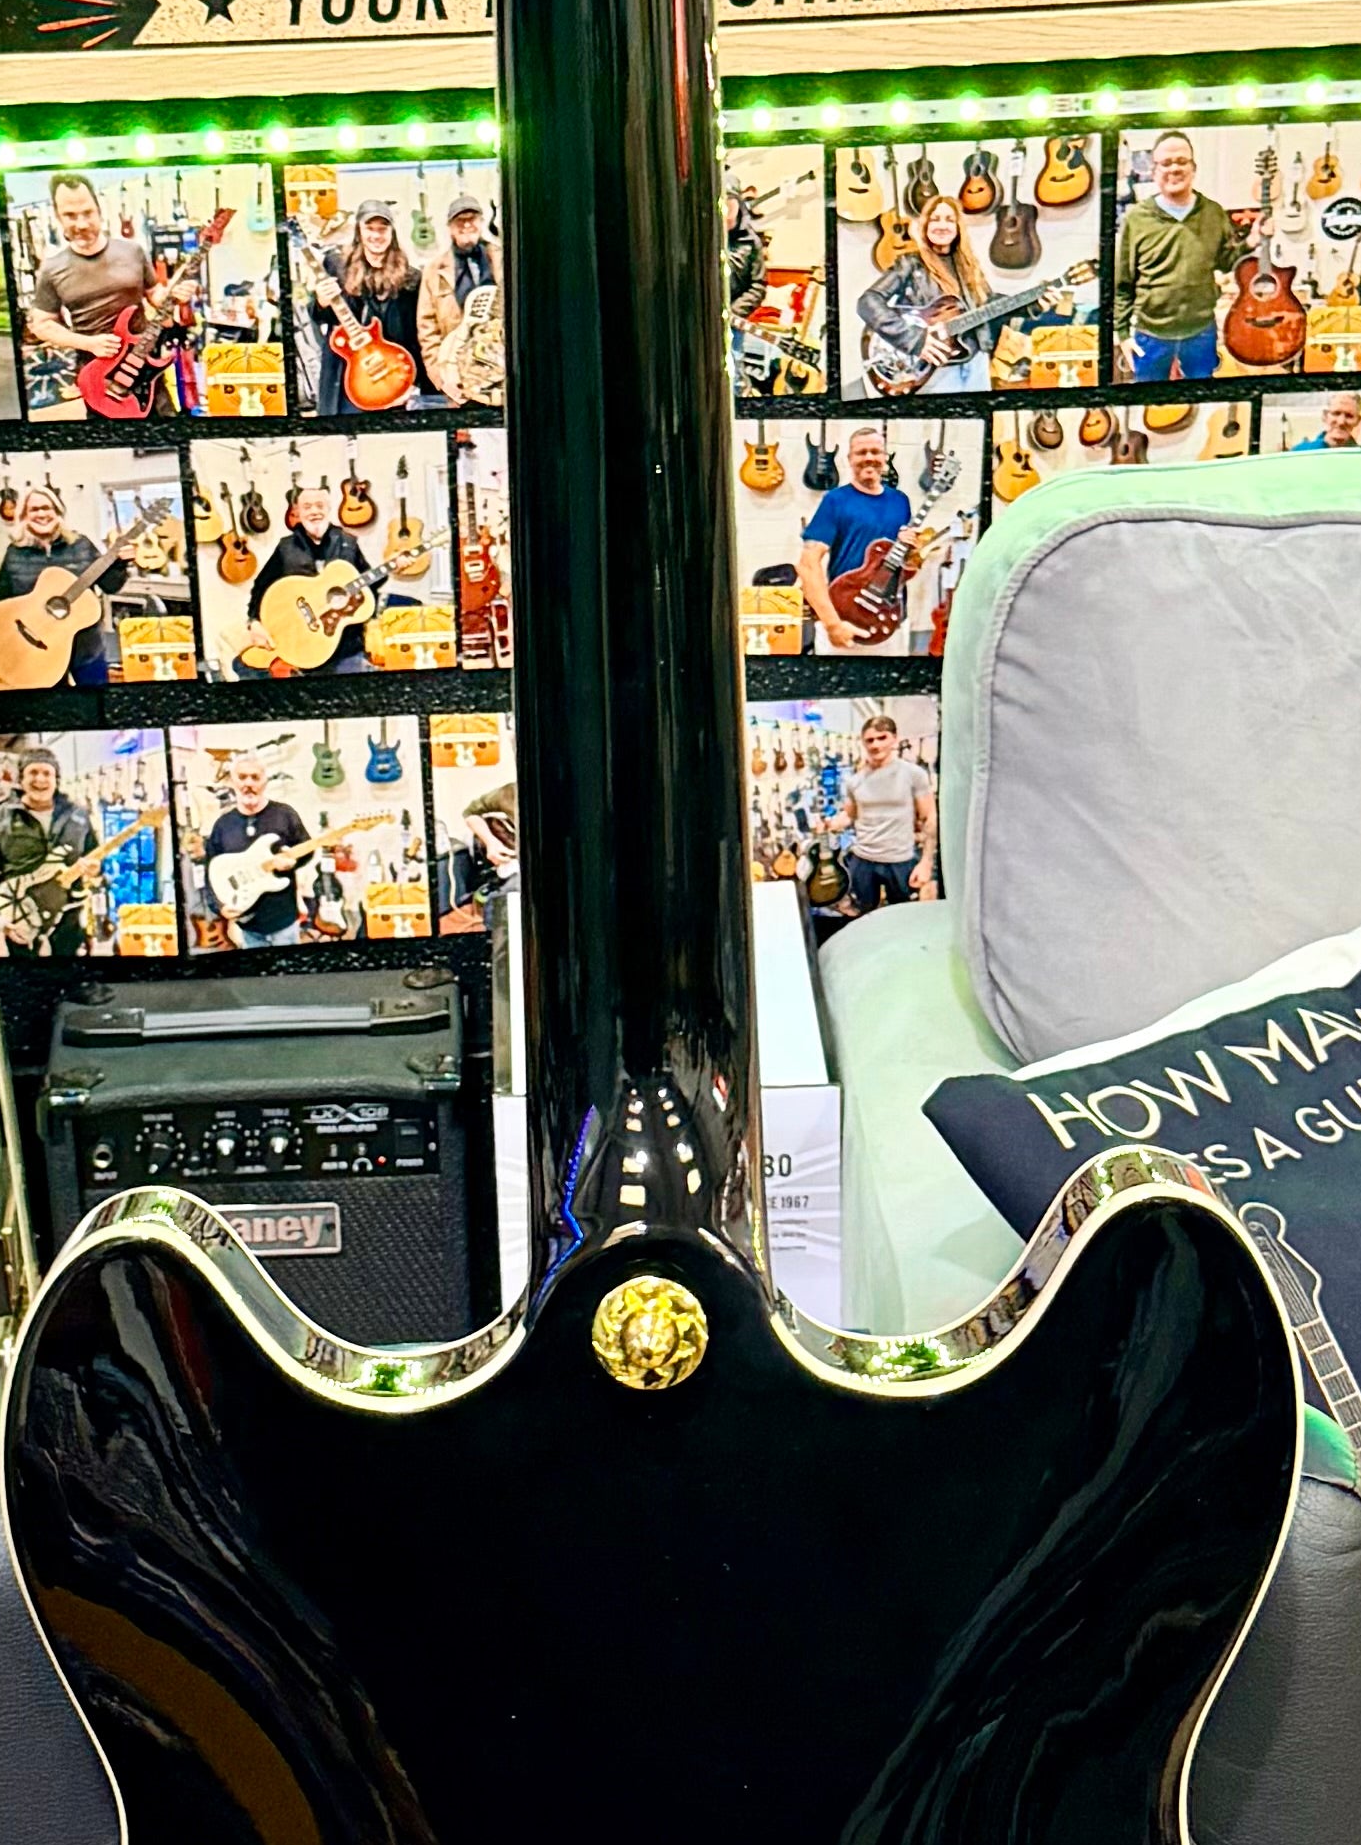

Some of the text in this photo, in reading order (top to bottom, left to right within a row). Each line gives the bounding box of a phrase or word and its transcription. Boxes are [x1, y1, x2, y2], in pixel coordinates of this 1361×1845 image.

[1026, 1050, 1230, 1151] HOW
[1184, 1143, 1253, 1185] ES
[1253, 1126, 1302, 1170] A
[239, 1212, 325, 1248] aney
